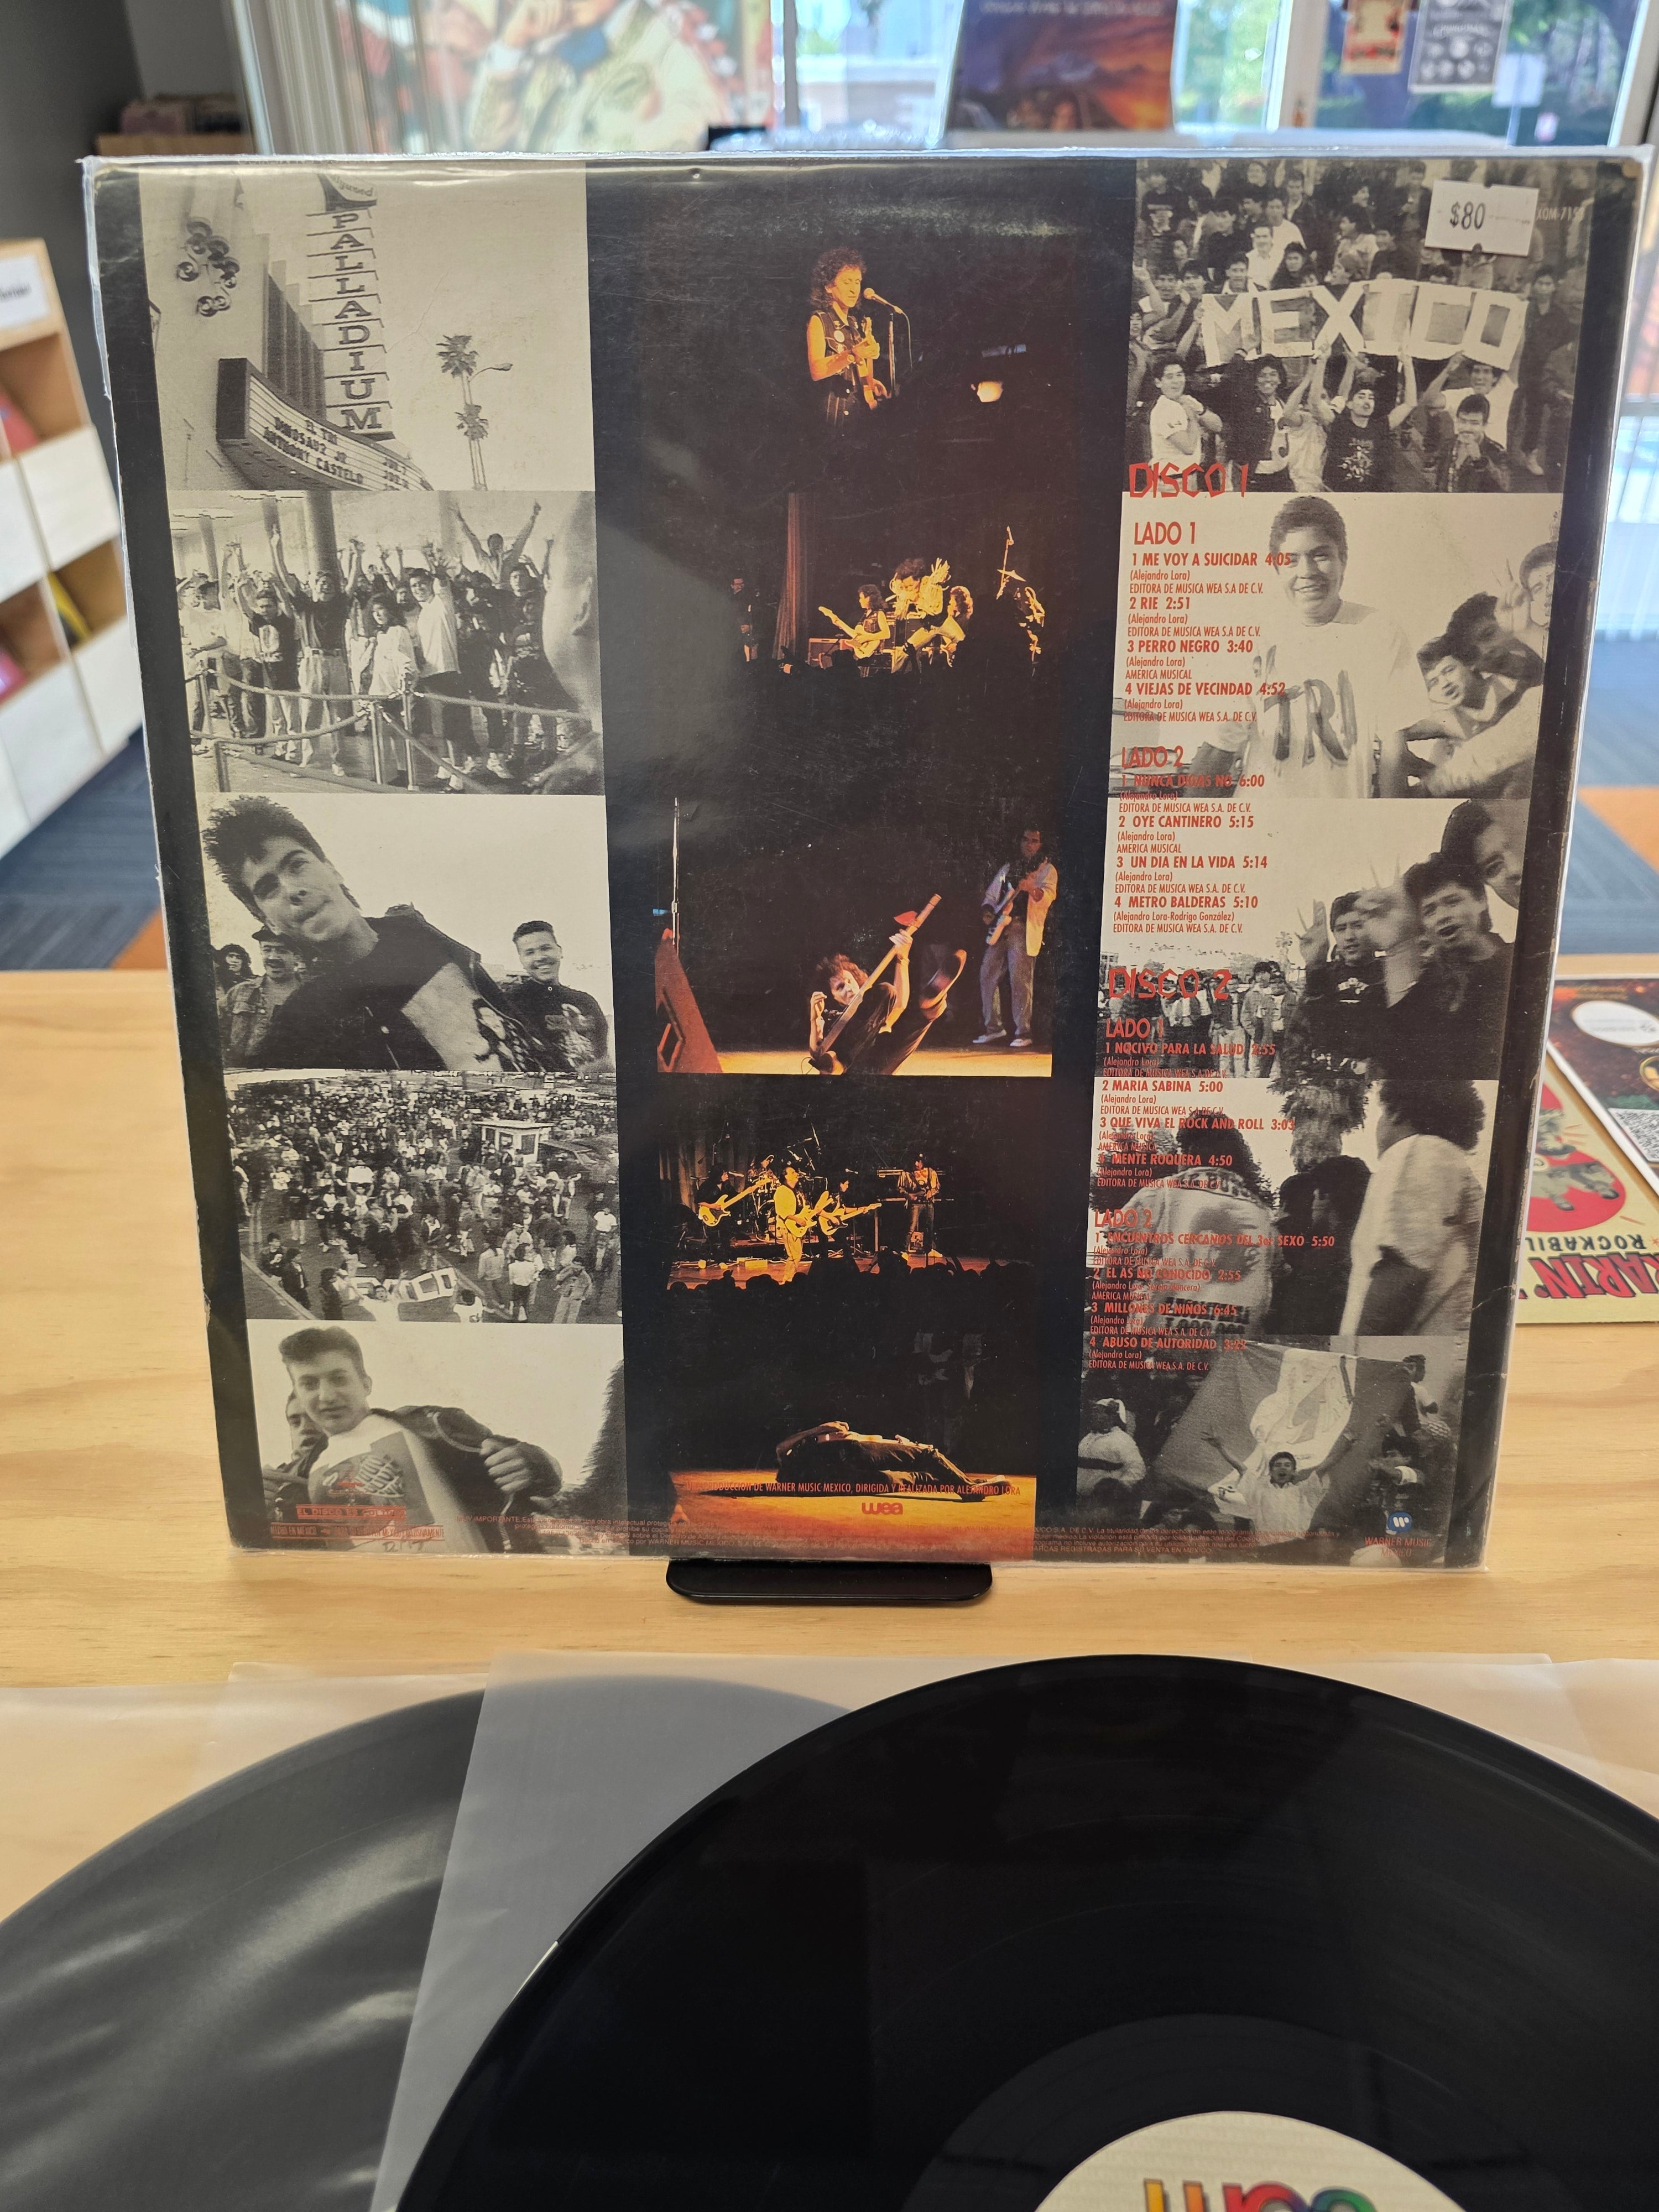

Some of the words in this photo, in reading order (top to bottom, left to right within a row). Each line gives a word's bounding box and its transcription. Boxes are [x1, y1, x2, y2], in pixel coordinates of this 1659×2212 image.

[1450, 201, 1485, 230] $80
[330, 213, 383, 430] PALLADIUM
[1202, 278, 1530, 372] MEXICO
[1129, 462, 1225, 498] DISCO
[1134, 521, 1182, 545] LADO
[1190, 522, 1196, 544] 1
[1133, 553, 1137, 565] 1
[1142, 553, 1159, 565] ME
[1164, 553, 1188, 566] VOY
[1192, 553, 1199, 565] A
[1204, 552, 1257, 566] SUICIDAR
[1265, 552, 1291, 566] 4:05
[1130, 571, 1168, 582] (Alejandro
[1170, 571, 1190, 580] Lora)
[1130, 583, 1161, 593] EDITORA
[1164, 583, 1173, 593] DE
[1175, 583, 1204, 593] MUSICA
[1206, 583, 1222, 593] WEA
[1238, 583, 1248, 593] DE
[1249, 582, 1262, 593] C.V.
[1130, 596, 1137, 609] 2
[1140, 597, 1157, 609] RIE
[1166, 596, 1190, 609] 2:51
[1128, 640, 1135, 653] 3
[1138, 640, 1176, 652] PERRO
[1180, 639, 1219, 652] NEGRO
[1227, 639, 1253, 652] 3:40
[1126, 669, 1158, 679] AMERICA
[1160, 669, 1191, 679] MUSICAL
[1125, 682, 1132, 695] 4
[1136, 682, 1173, 695] VIEJAS
[1177, 682, 1191, 696] DE
[1196, 682, 1252, 696] VECINDAD
[1259, 682, 1285, 696] 4:52
[1263, 669, 1358, 769] TRI
[1121, 747, 1168, 768] LADO
[1173, 746, 1183, 767] 2
[1134, 775, 1173, 786] NUNCA
[1176, 774, 1211, 786] DIGAS
[1214, 775, 1233, 787] NO
[1239, 775, 1265, 787] 6:00
[1119, 815, 1126, 827] 2
[1133, 816, 1154, 827] OYE
[1158, 816, 1222, 827] CANTINERO
[1229, 816, 1254, 828] 5:15
[1117, 843, 1148, 853] AMERICA
[1150, 843, 1181, 853] MUSICAL
[1117, 856, 1124, 868] 3
[1131, 857, 1147, 867] UN
[1151, 856, 1170, 868] DIA
[1173, 856, 1187, 867] EN
[1191, 856, 1204, 868] LA
[1208, 856, 1235, 868] VIDA
[1243, 856, 1267, 868] 5:14
[1115, 896, 1121, 906] 4
[1129, 896, 1167, 907] METRO
[1171, 896, 1225, 907] BALDERAS
[1234, 895, 1258, 908] 5:10
[1114, 911, 1150, 922] (Alejandro
[1152, 911, 1197, 922] Lora-Rodrigo
[1199, 911, 1234, 922] González)
[1108, 967, 1199, 999] DISCO
[1213, 970, 1232, 1000] 2
[1105, 1018, 1150, 1039] LADO
[1157, 1019, 1164, 1037] 1
[1105, 1044, 1111, 1053] 1
[1114, 1043, 1157, 1054] NOCIVO
[1161, 1044, 1190, 1054] PARA
[1193, 1044, 1206, 1055] LA
[1209, 1044, 1244, 1055] SALUD
[1102, 1080, 1109, 1091] 2
[1112, 1081, 1148, 1091] MARIA
[1152, 1081, 1191, 1091] SABINA
[1199, 1081, 1223, 1092] 5:00
[1100, 1117, 1107, 1128] 3
[1110, 1117, 1131, 1128] QUE
[1135, 1118, 1160, 1128] VIVA
[1165, 1118, 1174, 1128] EL
[1178, 1118, 1208, 1129] ROCK
[1211, 1119, 1234, 1129] AND
[1237, 1118, 1263, 1130] ROLL
[1271, 1119, 1295, 1130] 3:03
[1112, 1153, 1146, 1164] MENTE
[1150, 1154, 1201, 1165] ROQUERA
[1208, 1155, 1233, 1166] 4:50
[1094, 1208, 1138, 1227] LADO
[1143, 1209, 1152, 1228] 2
[1095, 1232, 1100, 1242] 1
[1107, 1232, 1174, 1243] ENCUENTROS
[1178, 1233, 1232, 1245] CERCANOS
[1235, 1234, 1254, 1246] DEL
[1277, 1235, 1305, 1247] SEXO
[1311, 1235, 1334, 1247] 5:50
[1525, 1234, 1646, 1251] ROCKABIL
[1093, 1268, 1100, 1279] 2
[1106, 1267, 1116, 1279] EL
[1120, 1268, 1133, 1279] AS
[1136, 1269, 1152, 1279] NO
[1156, 1269, 1210, 1280] CONOCIDO
[1092, 1302, 1098, 1313] 3
[1104, 1302, 1154, 1314] MILLONES
[1157, 1304, 1171, 1314] DE
[1173, 1302, 1207, 1315] NIÑOS
[1213, 1306, 1237, 1316] 6:45
[1089, 1337, 1096, 1347] 4
[1103, 1337, 1138, 1348] ABUSO
[1140, 1338, 1152, 1348] DE
[1156, 1338, 1215, 1349] AUTORIDAD
[766, 1483, 795, 1491] WARNER
[798, 1483, 821, 1491] MUSIC
[856, 1484, 889, 1493] DIRIGIDA
[891, 1484, 896, 1493] Y
[941, 1484, 954, 1493] POR
[957, 1485, 999, 1494] ALEJANDRO
[1001, 1486, 1020, 1495] LORA
[862, 1503, 902, 1514] wea
[1365, 1537, 1402, 1545] WARNER
[1405, 1538, 1431, 1547] MUSIC
